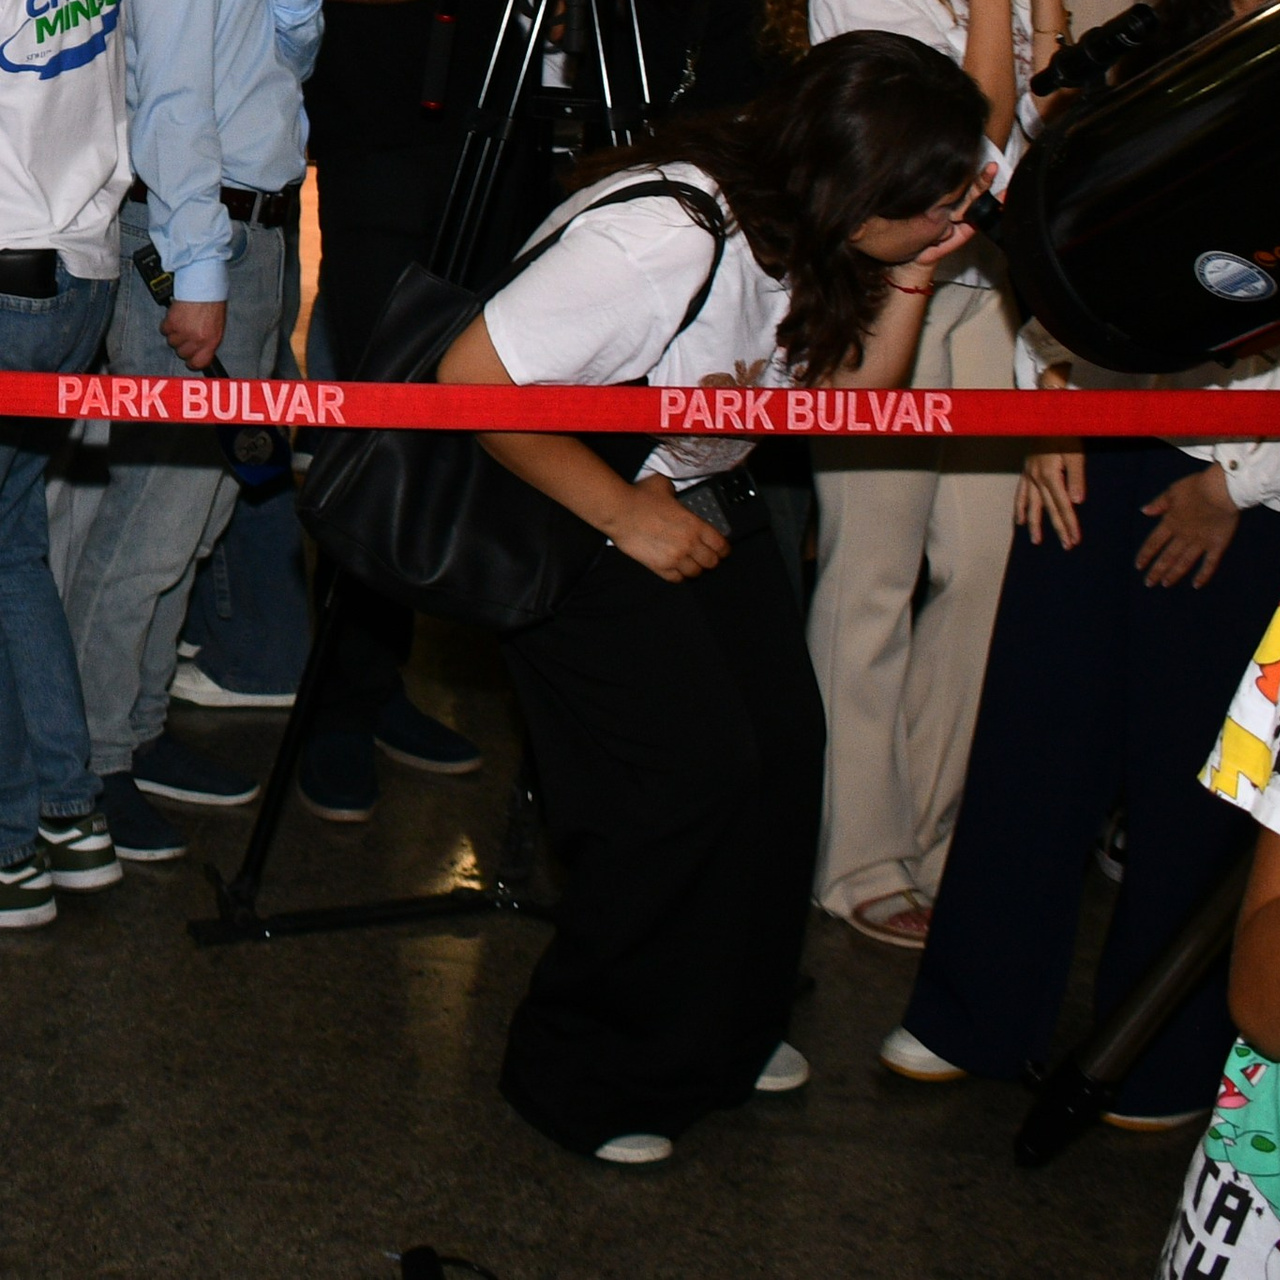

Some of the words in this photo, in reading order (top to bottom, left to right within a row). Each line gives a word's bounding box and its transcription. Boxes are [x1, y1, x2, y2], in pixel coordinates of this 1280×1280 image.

[58, 376, 169, 418] PARK
[182, 380, 346, 424] BULVAR
[660, 389, 774, 431] PARK
[787, 391, 952, 433] BULVAR
